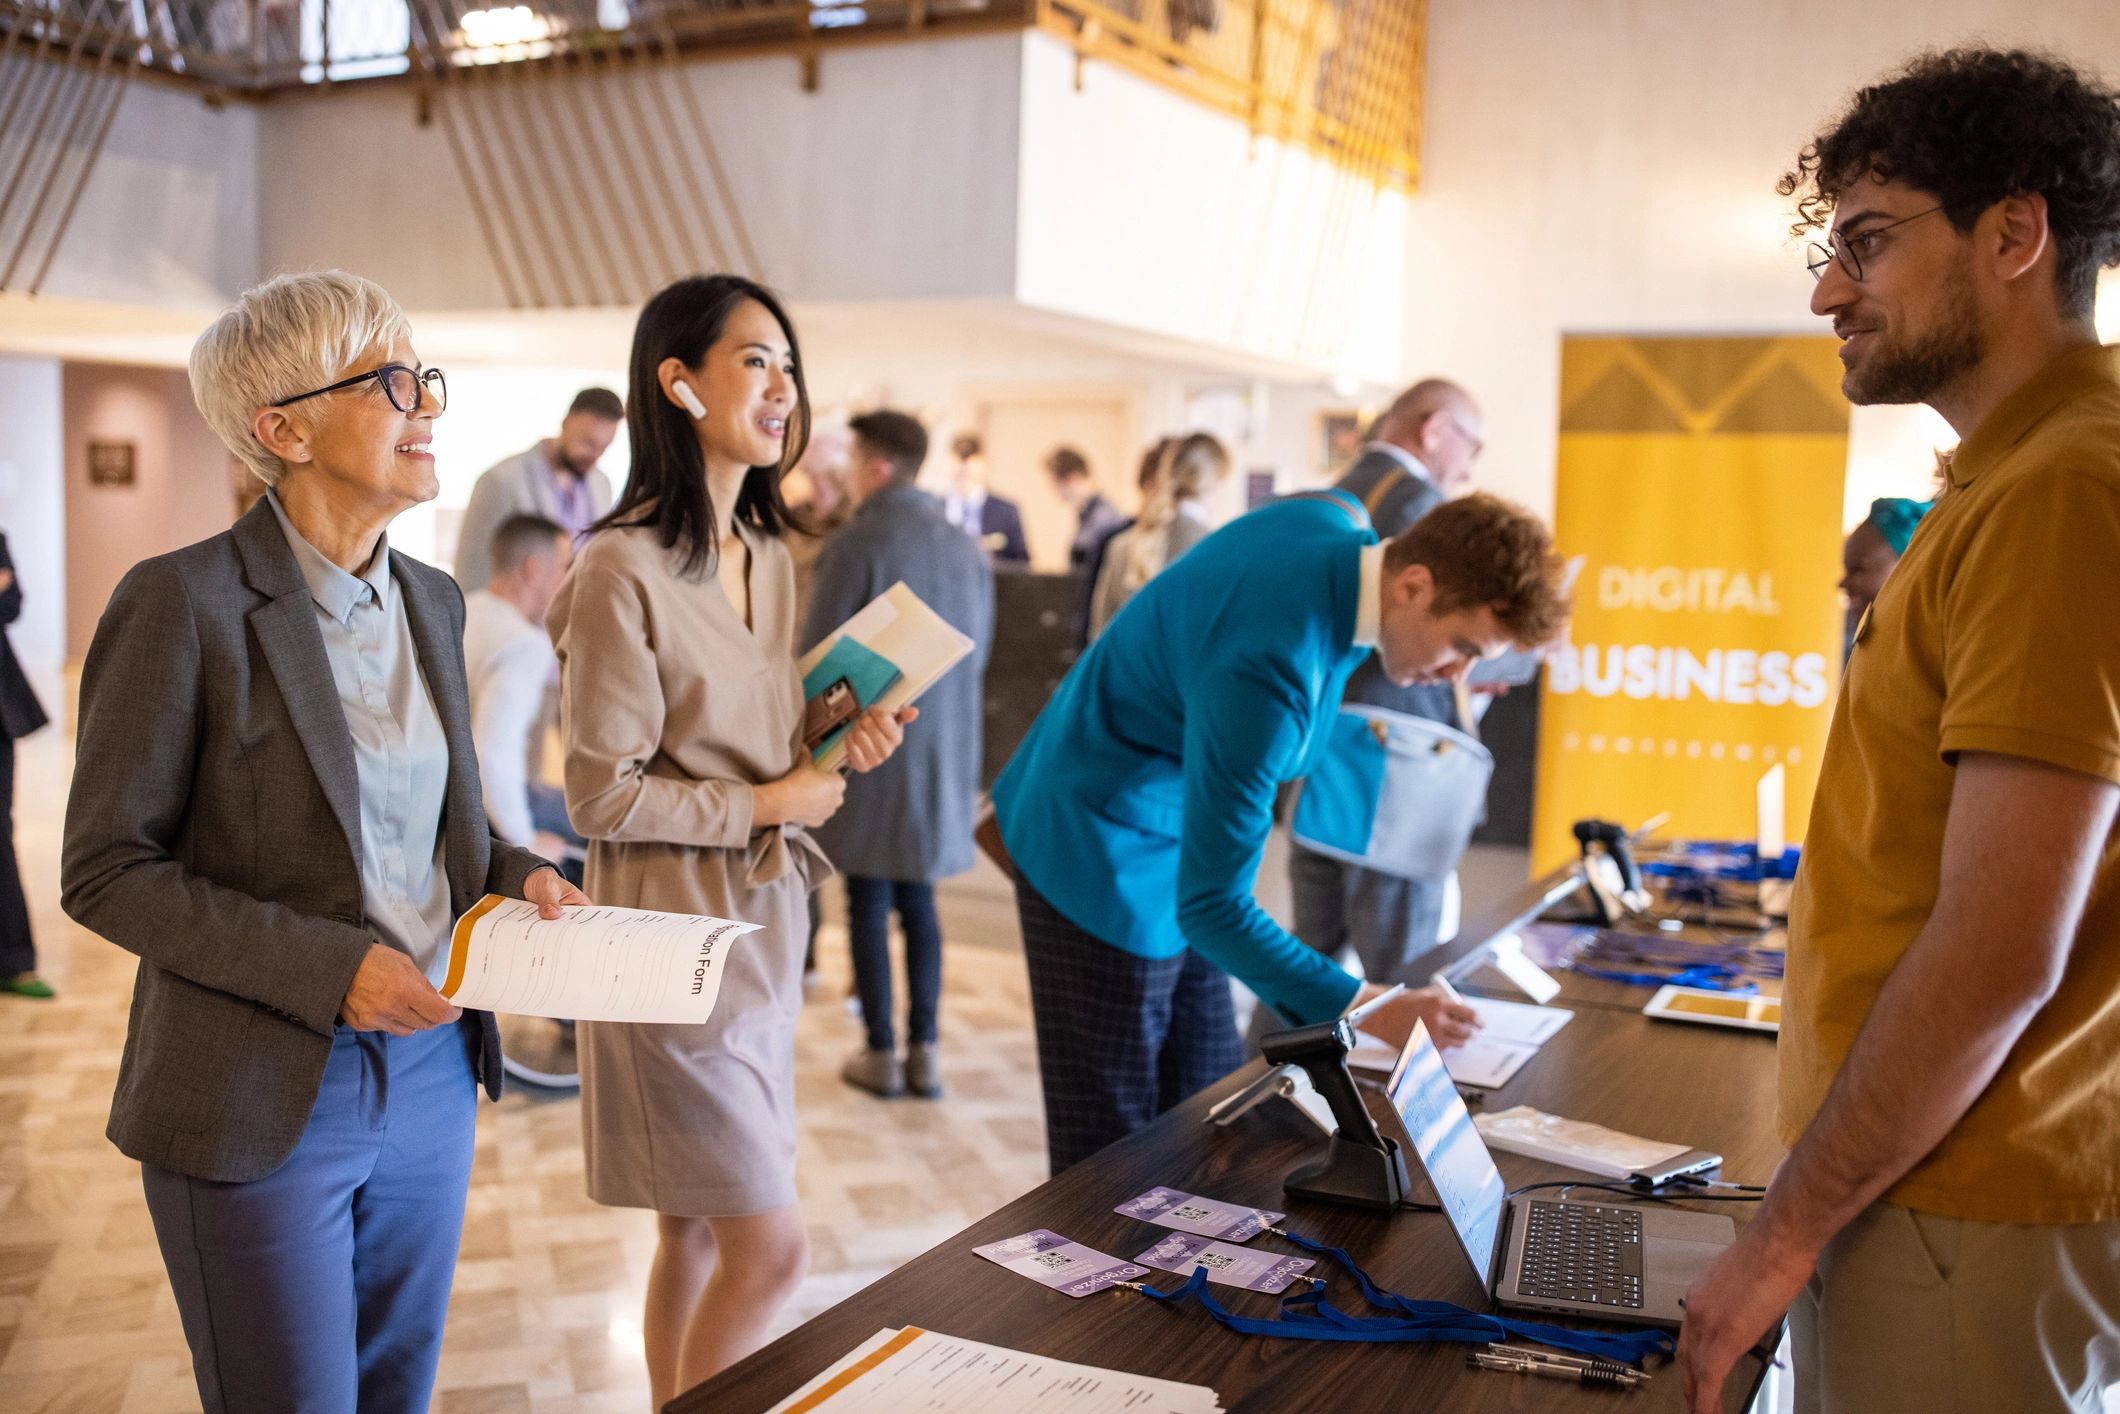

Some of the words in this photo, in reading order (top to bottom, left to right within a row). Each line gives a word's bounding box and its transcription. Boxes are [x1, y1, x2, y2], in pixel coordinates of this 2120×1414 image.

[1598, 566, 1779, 614] DIGITAL
[1550, 644, 1828, 708] BUSINESS
[691, 959, 711, 995] Form
[1070, 1267, 1138, 1291] Organizer
[1260, 1260, 1304, 1289] Organizer
